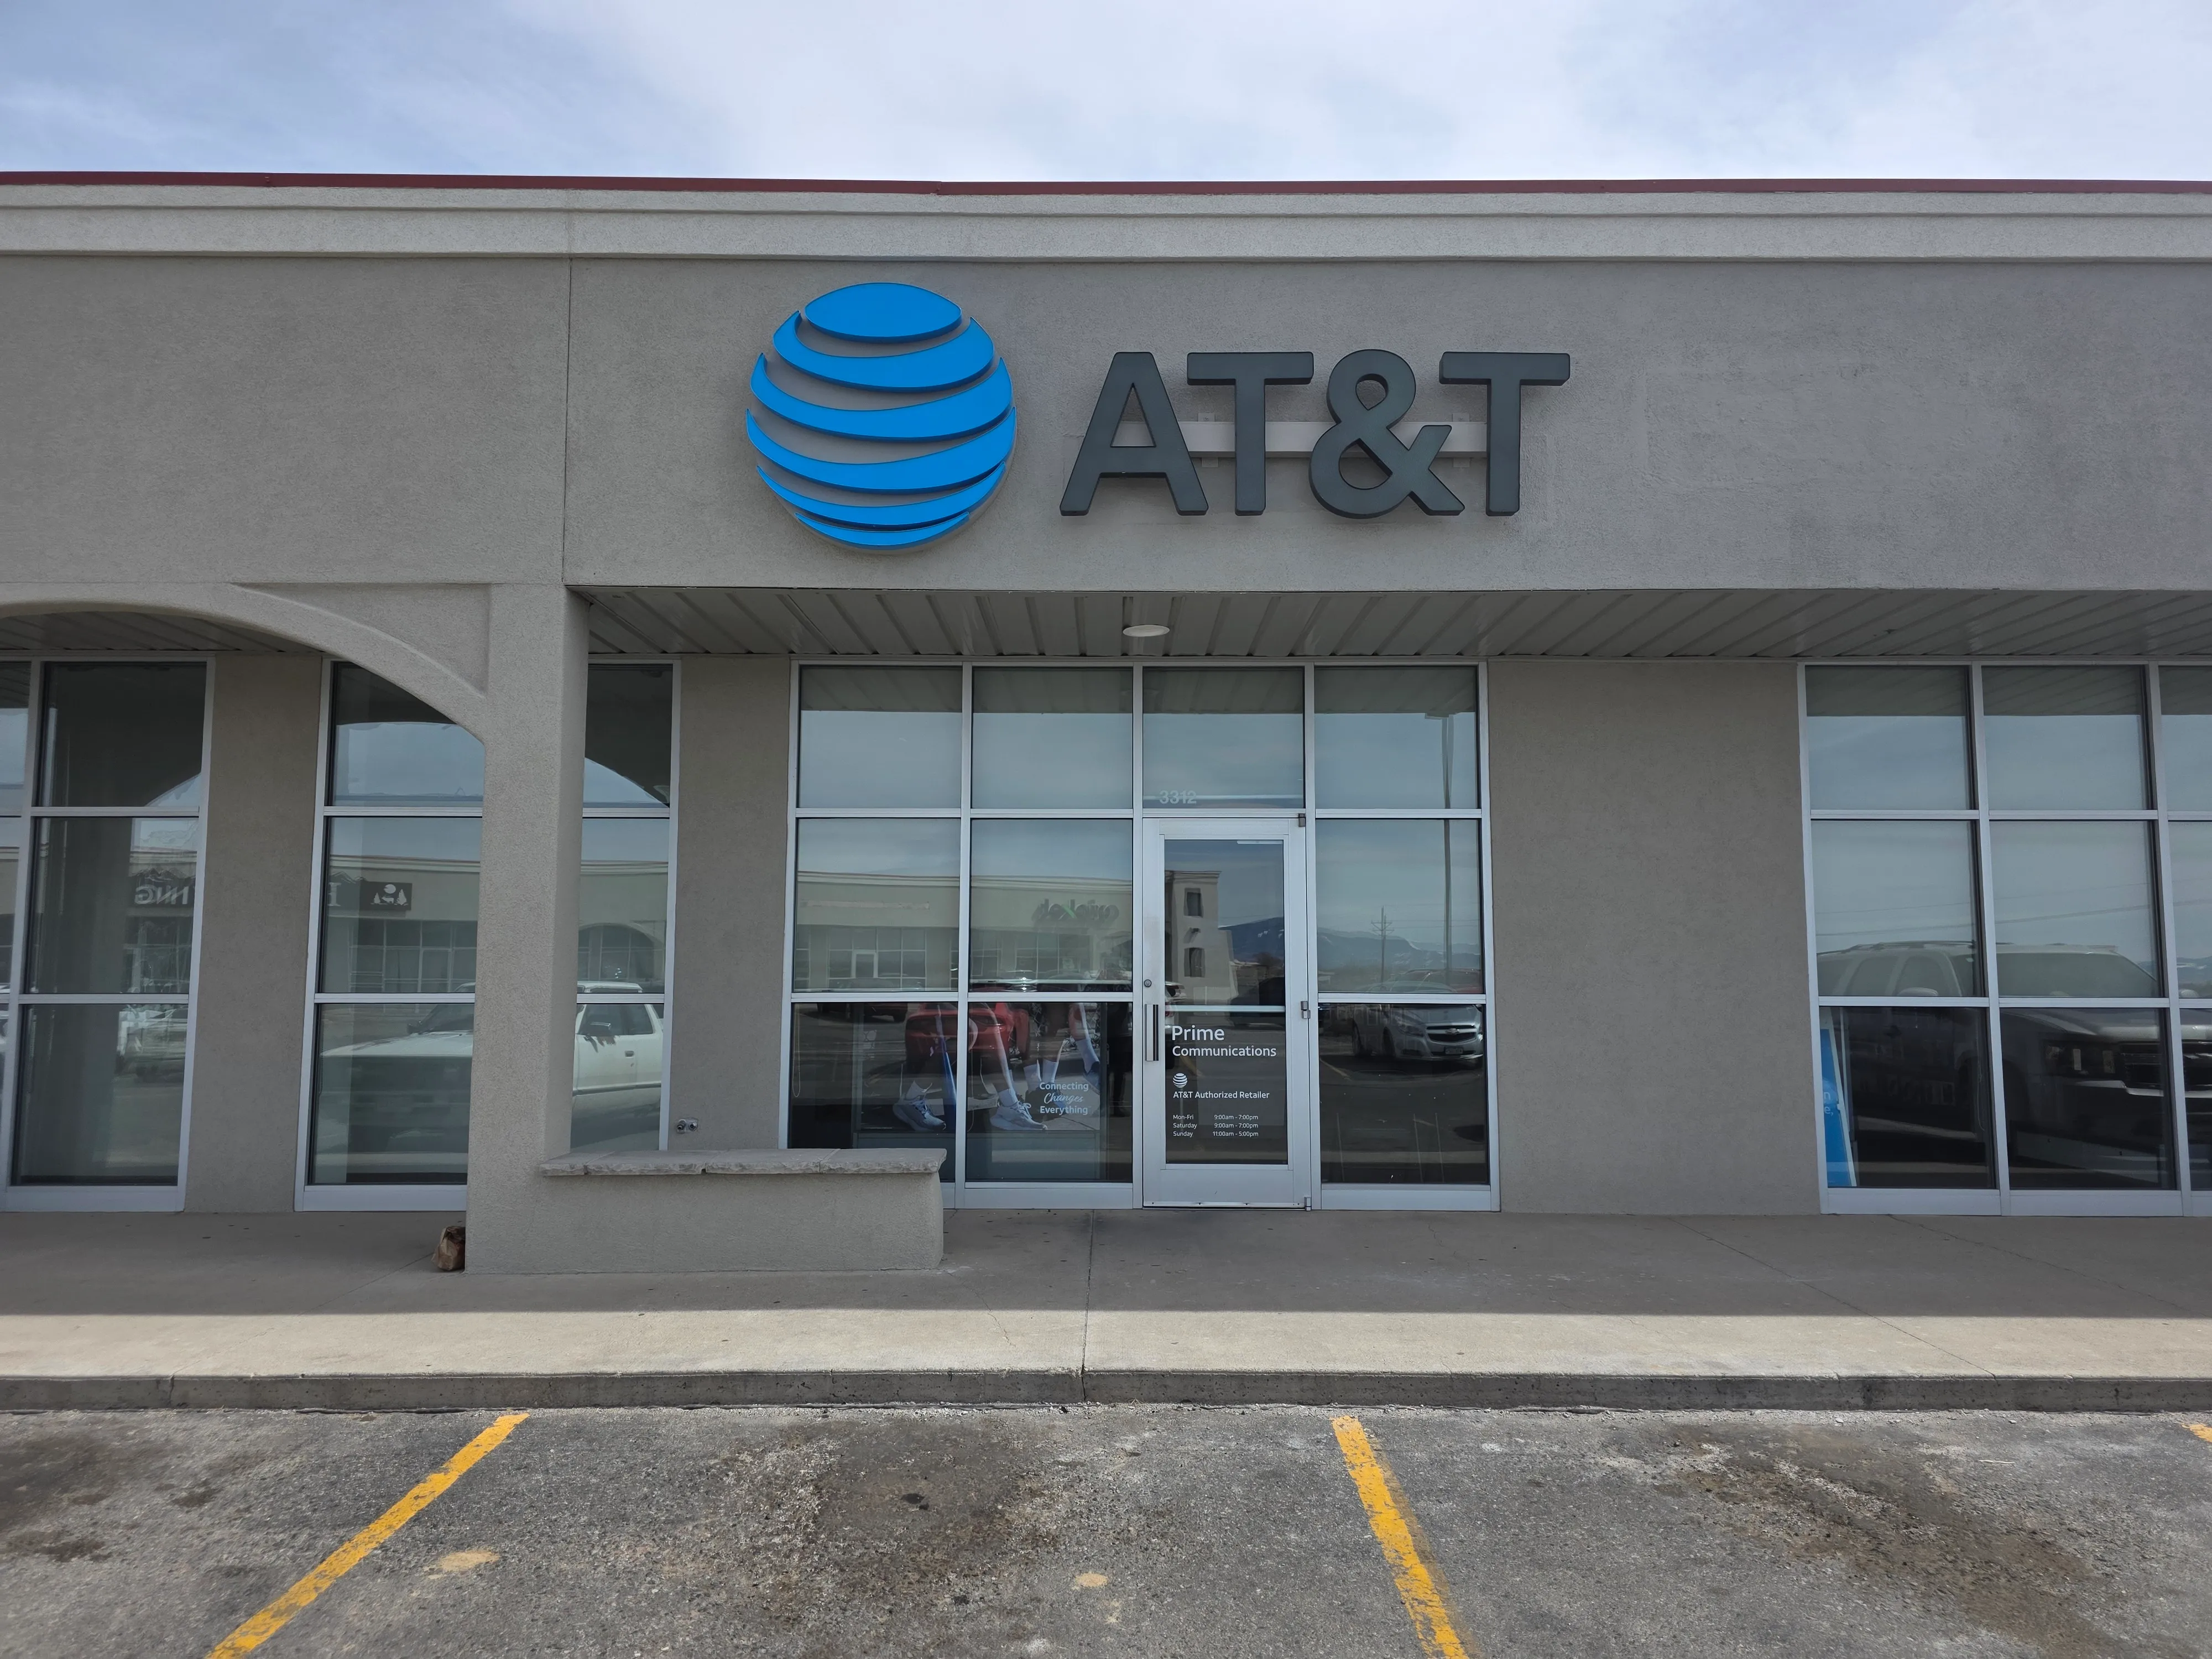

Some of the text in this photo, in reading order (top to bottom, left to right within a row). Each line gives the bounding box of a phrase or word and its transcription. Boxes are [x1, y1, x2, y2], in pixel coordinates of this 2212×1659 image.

[1060, 349, 1570, 519] AT&T
[1160, 790, 1197, 804] 3312
[1172, 1025, 1224, 1041] Prime
[1172, 1045, 1276, 1057] Communications
[1040, 1082, 1089, 1092] Connecting
[1044, 1092, 1084, 1104] Changes
[1040, 1106, 1088, 1115] Everything
